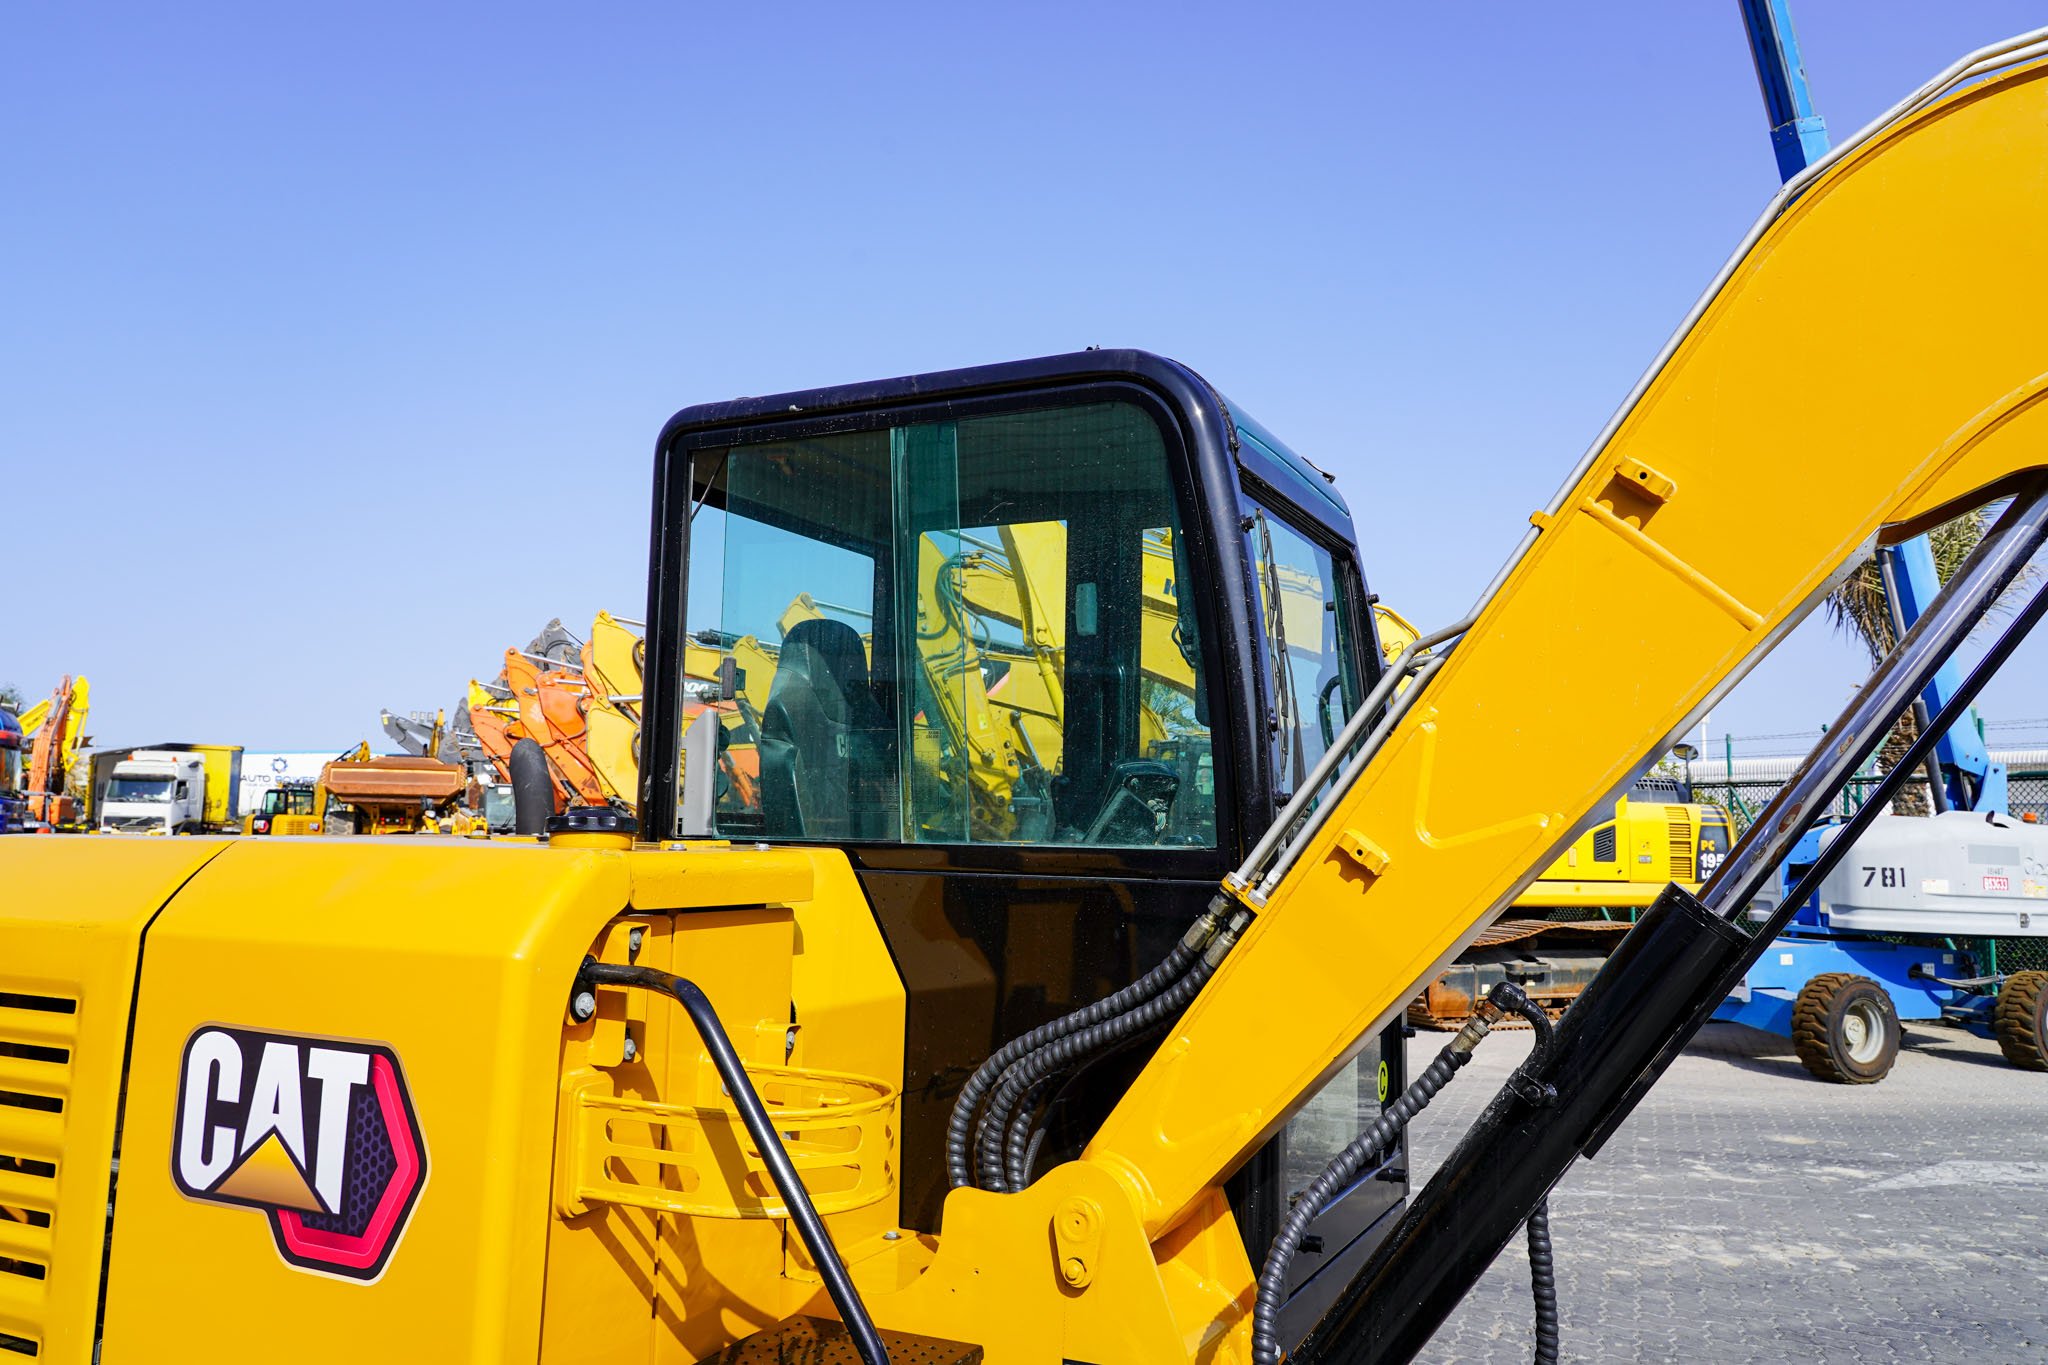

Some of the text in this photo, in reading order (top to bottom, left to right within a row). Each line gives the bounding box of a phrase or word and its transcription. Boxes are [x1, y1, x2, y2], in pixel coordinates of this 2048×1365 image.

[240, 775, 271, 783] AUTO
[1700, 840, 1715, 851] PC
[1700, 853, 1725, 868] 195
[1862, 866, 1906, 888] 781
[180, 1031, 370, 1215] CAT
